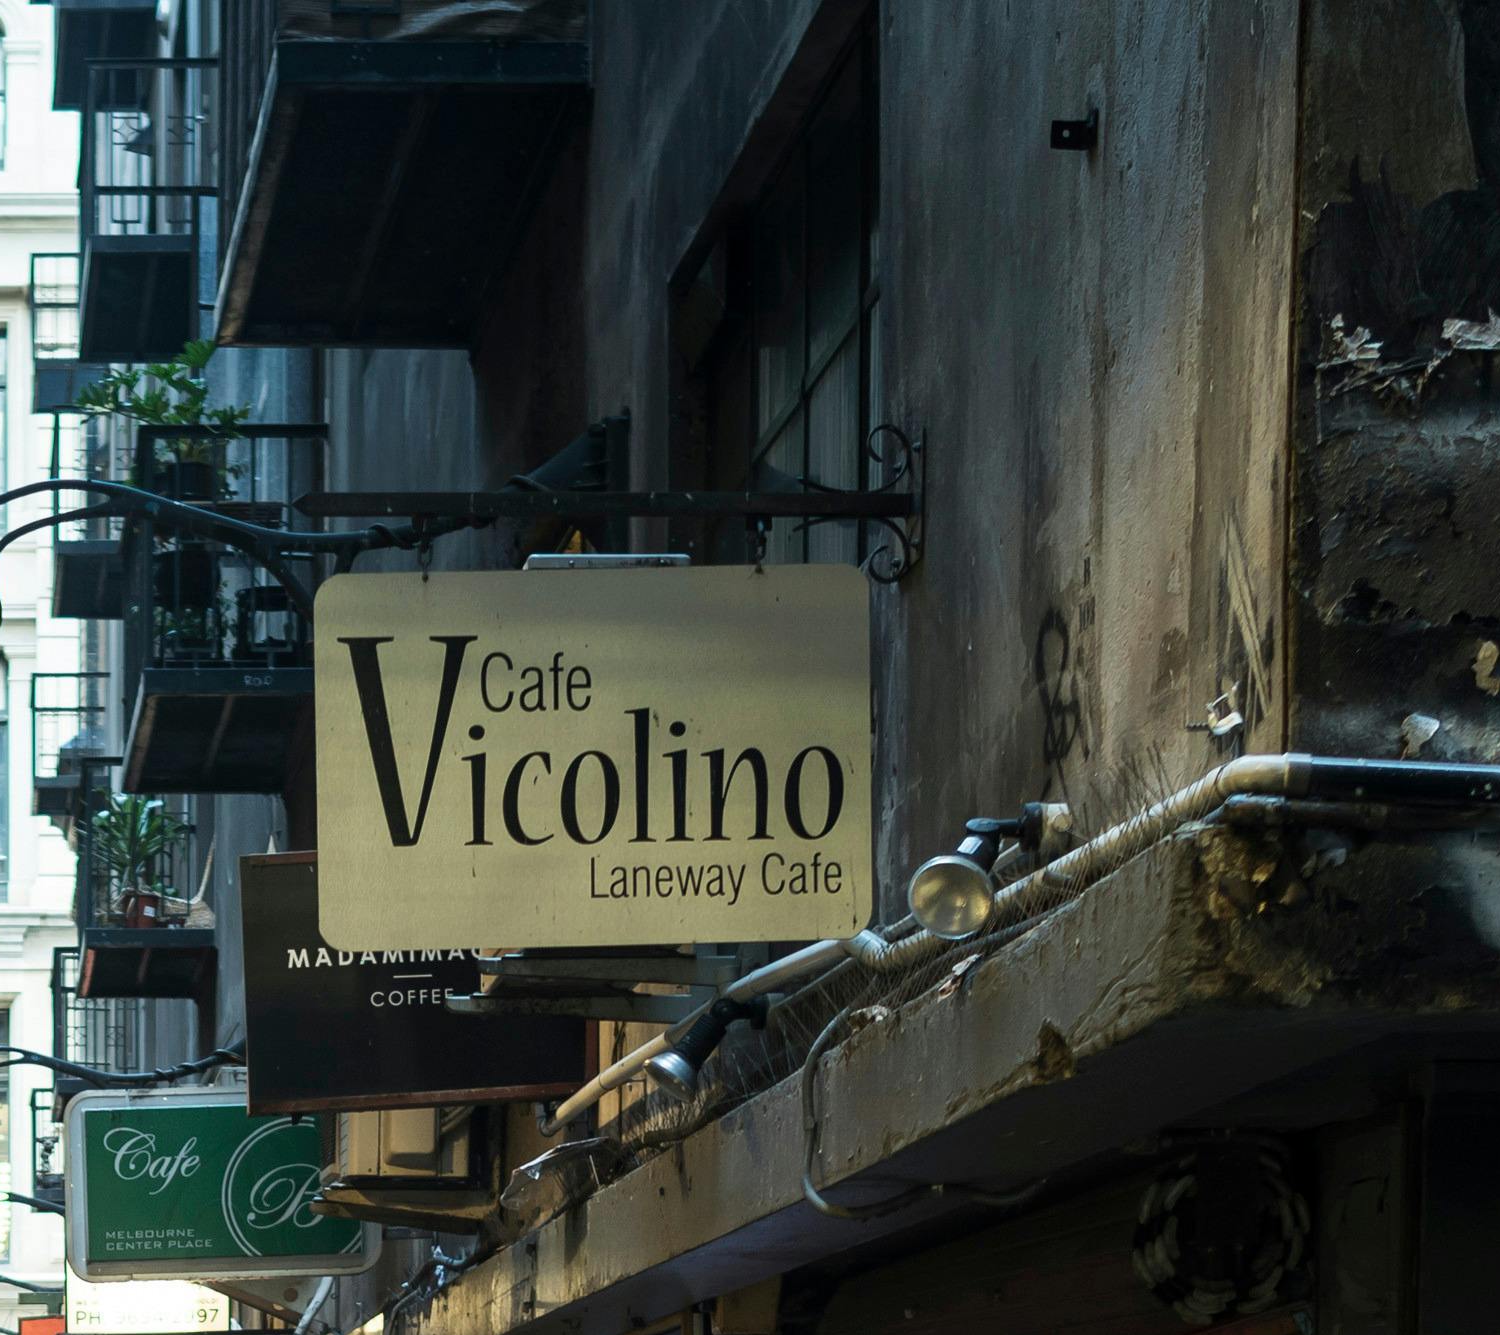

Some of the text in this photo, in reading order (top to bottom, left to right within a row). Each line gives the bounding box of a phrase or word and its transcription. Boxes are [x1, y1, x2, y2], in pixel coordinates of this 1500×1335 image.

[480, 652, 593, 713] Cafe
[336, 634, 845, 848] Vicolino
[589, 851, 845, 905] Laneway Cafe
[103, 1127, 201, 1195] Cafe
[105, 1228, 196, 1240] MELBOURNE
[105, 1238, 214, 1251] CENTER PLACE
